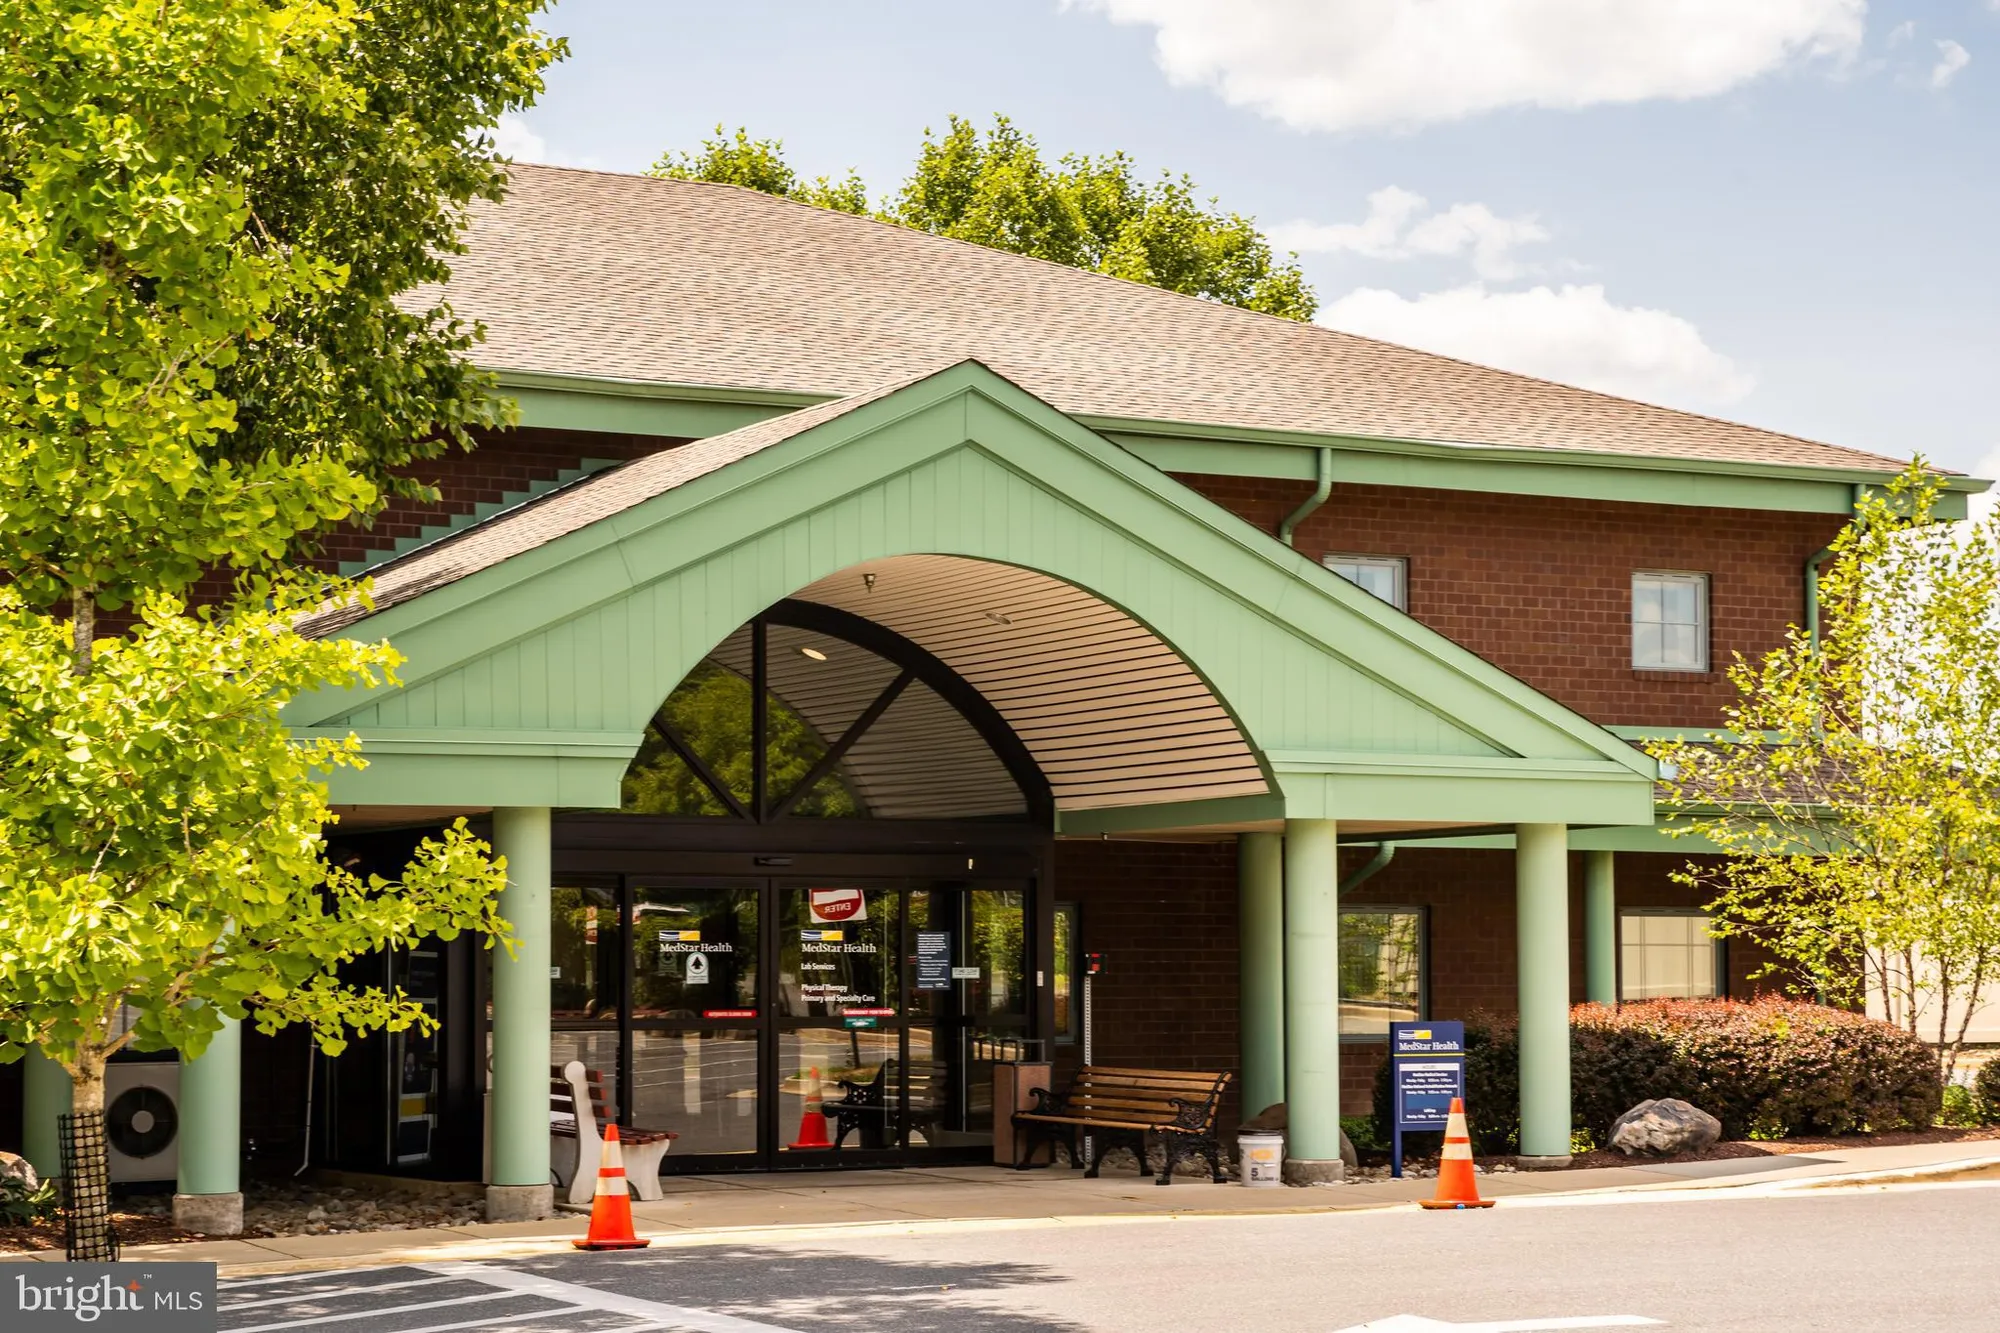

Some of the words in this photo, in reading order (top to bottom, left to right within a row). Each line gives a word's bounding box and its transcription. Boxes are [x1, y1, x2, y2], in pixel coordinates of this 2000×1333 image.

[659, 943, 699, 952] MedStar
[700, 942, 733, 952] Health
[801, 943, 842, 953] MedStar
[843, 943, 877, 953] Health
[812, 963, 836, 971] Services
[801, 984, 824, 992] Physical
[824, 984, 848, 993] Therapy
[801, 995, 824, 1003] Primary
[836, 994, 862, 1003] Specialty
[1399, 1042, 1431, 1051] MedStar
[1432, 1041, 1460, 1050] Health
[1250, 1168, 1258, 1176] 5
